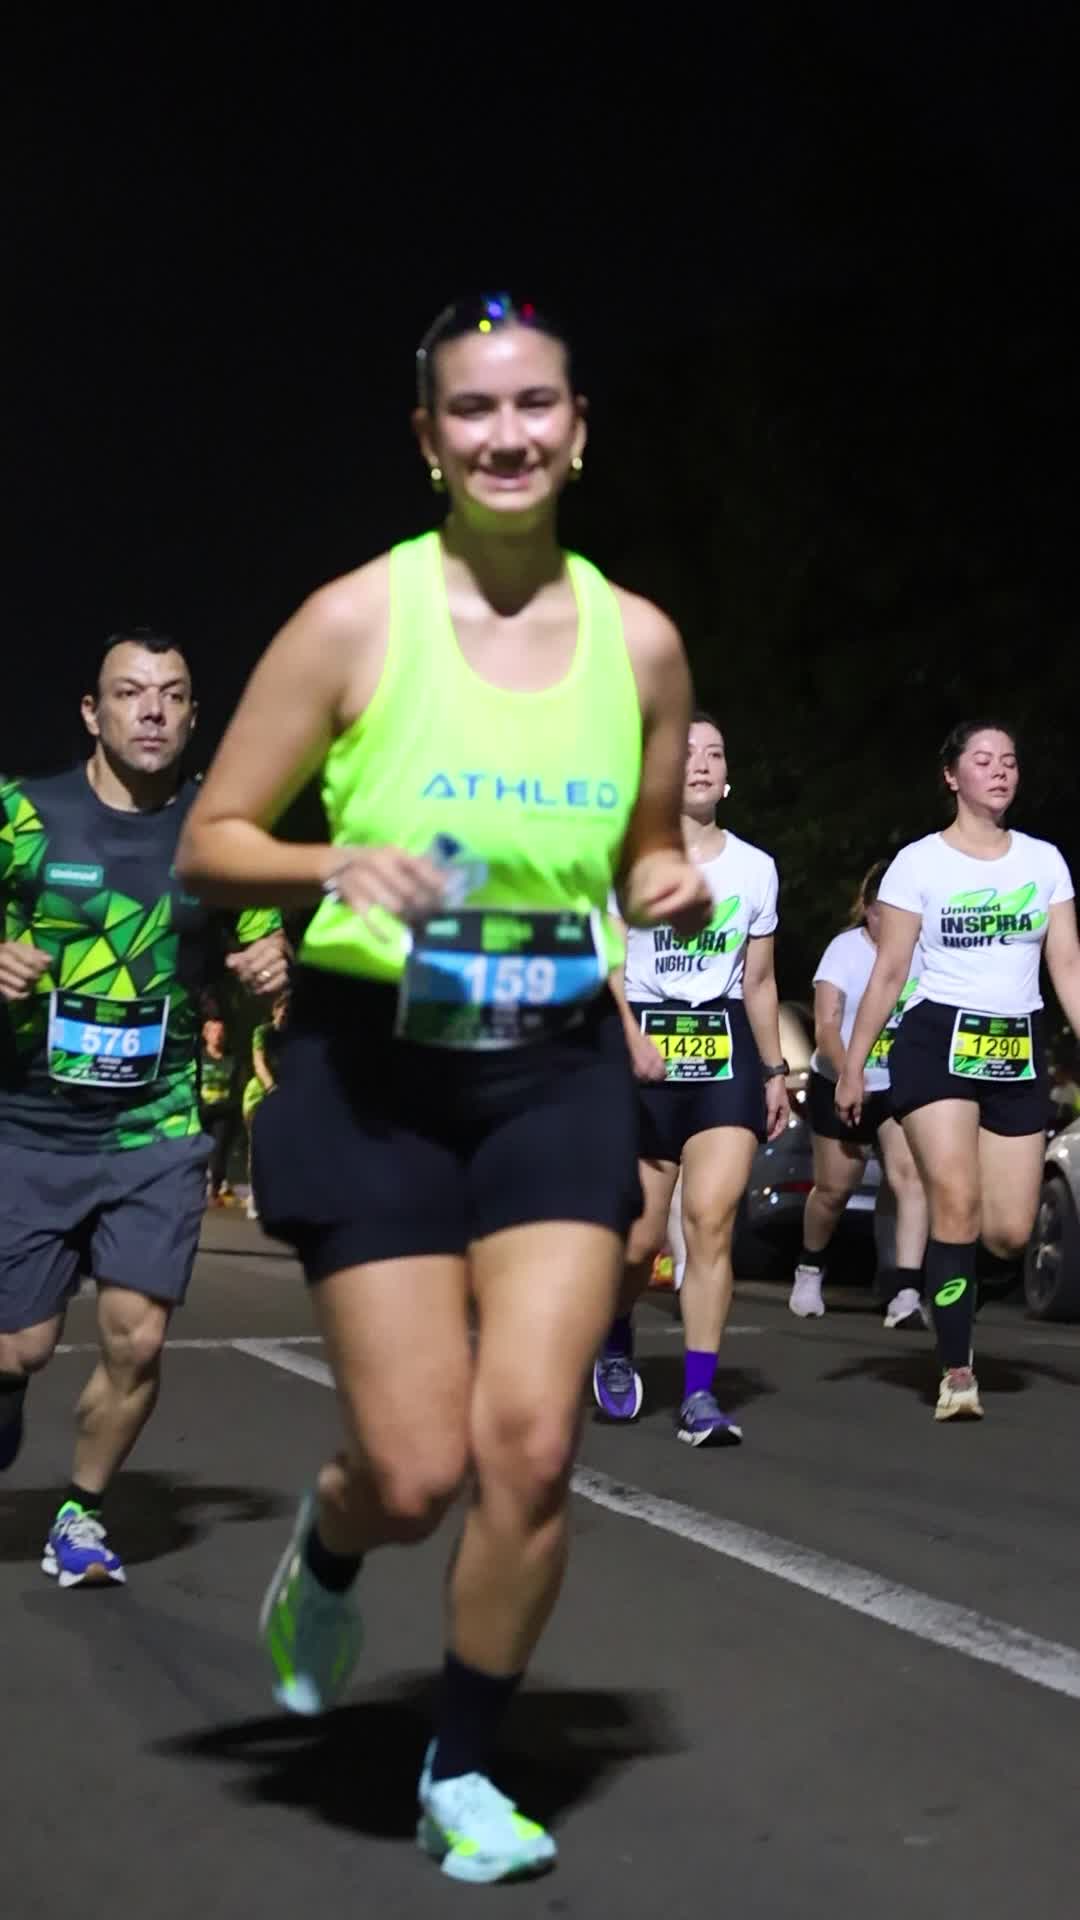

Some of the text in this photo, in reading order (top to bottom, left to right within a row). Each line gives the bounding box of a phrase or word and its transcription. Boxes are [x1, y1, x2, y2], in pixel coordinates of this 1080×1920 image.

[941, 904, 1001, 915] Unimed
[941, 914, 1032, 934] INSPIRA
[942, 935, 995, 948] NIGHT
[655, 955, 694, 974] NIGHT
[463, 955, 556, 1004] 159
[81, 1024, 141, 1057] 576
[660, 1036, 717, 1057] 1428
[973, 1036, 1021, 1058] 1290
